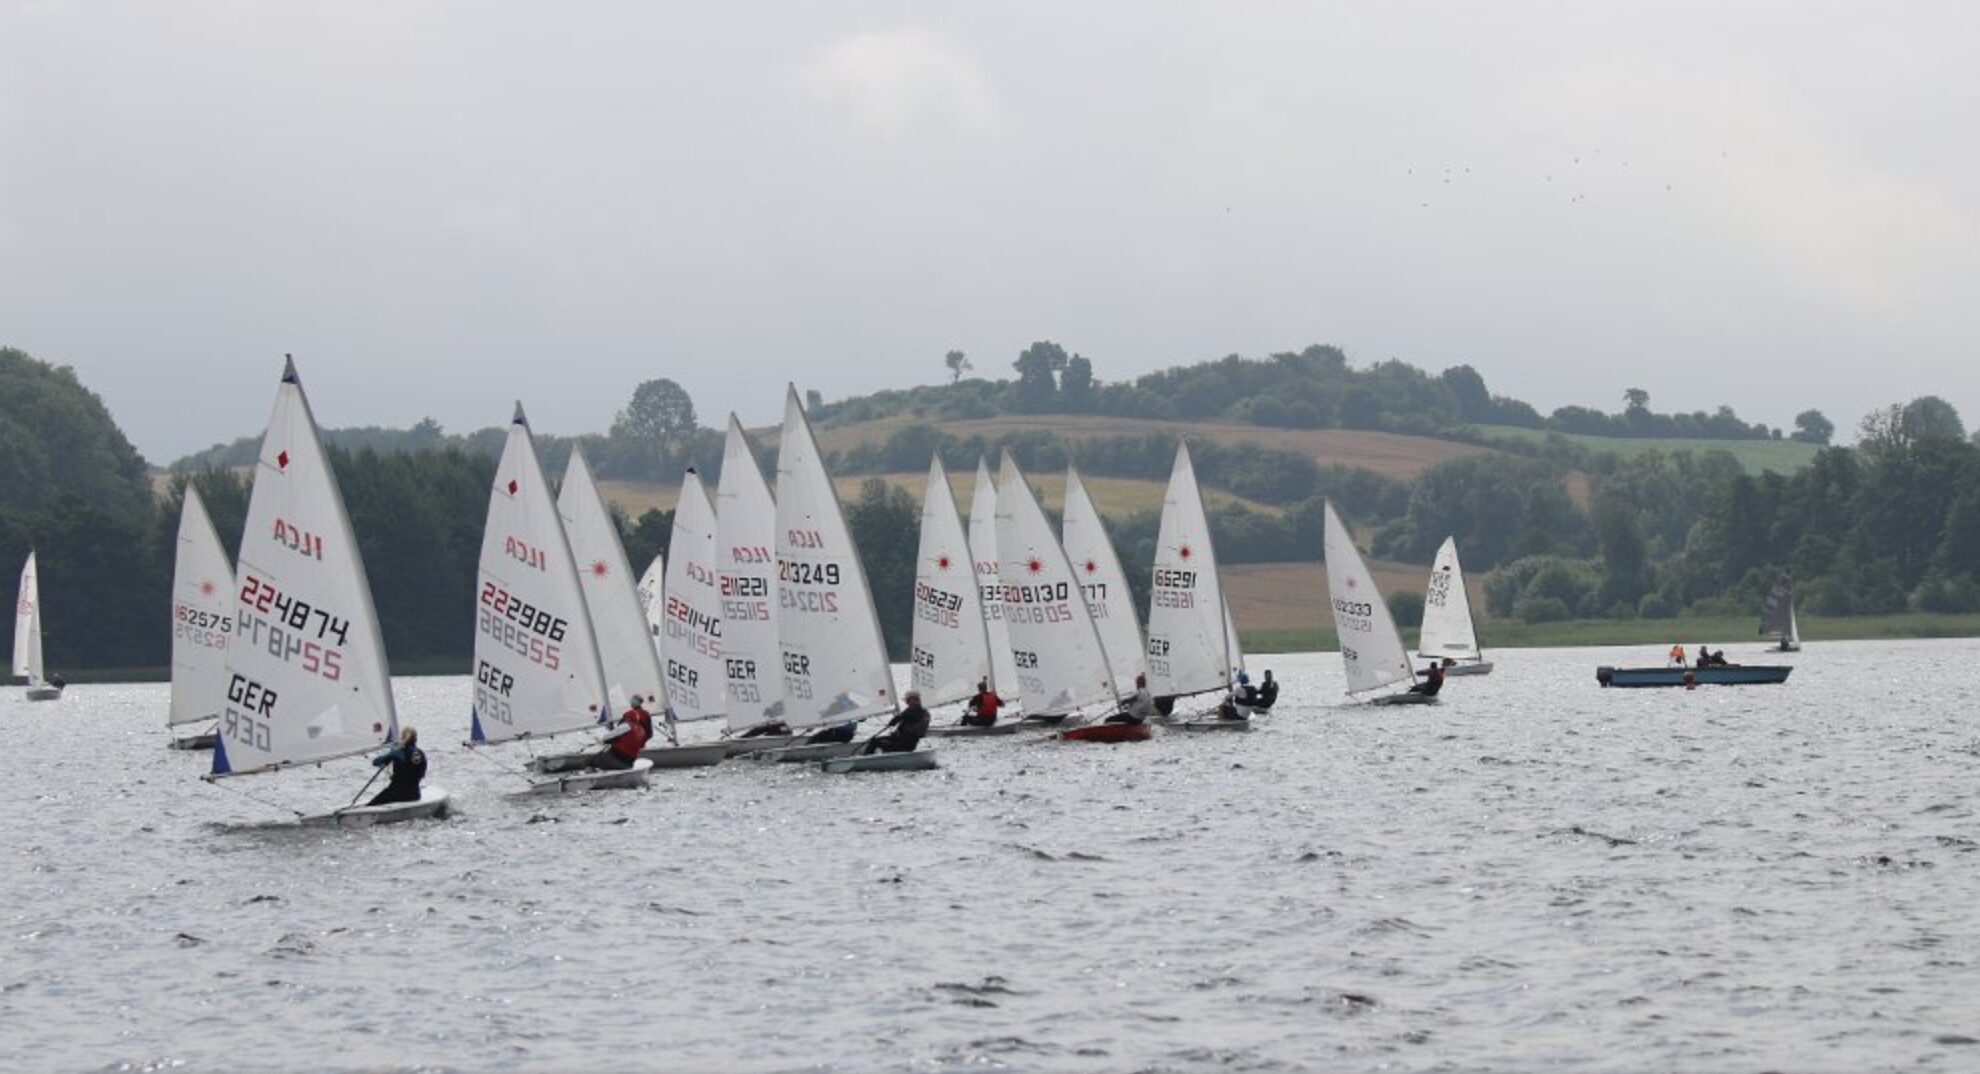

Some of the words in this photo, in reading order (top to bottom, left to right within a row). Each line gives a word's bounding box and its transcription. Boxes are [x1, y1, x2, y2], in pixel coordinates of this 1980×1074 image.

[720, 575, 768, 597] 211221
[778, 560, 840, 585] 213249
[1003, 582, 1068, 603] 208130
[176, 604, 232, 633] 162575
[240, 575, 350, 647] 224874
[480, 581, 568, 643] 222986
[668, 659, 698, 688] GER
[726, 659, 756, 680] GER
[783, 651, 810, 676] GER
[478, 660, 514, 697] GER
[227, 673, 278, 719] GER
